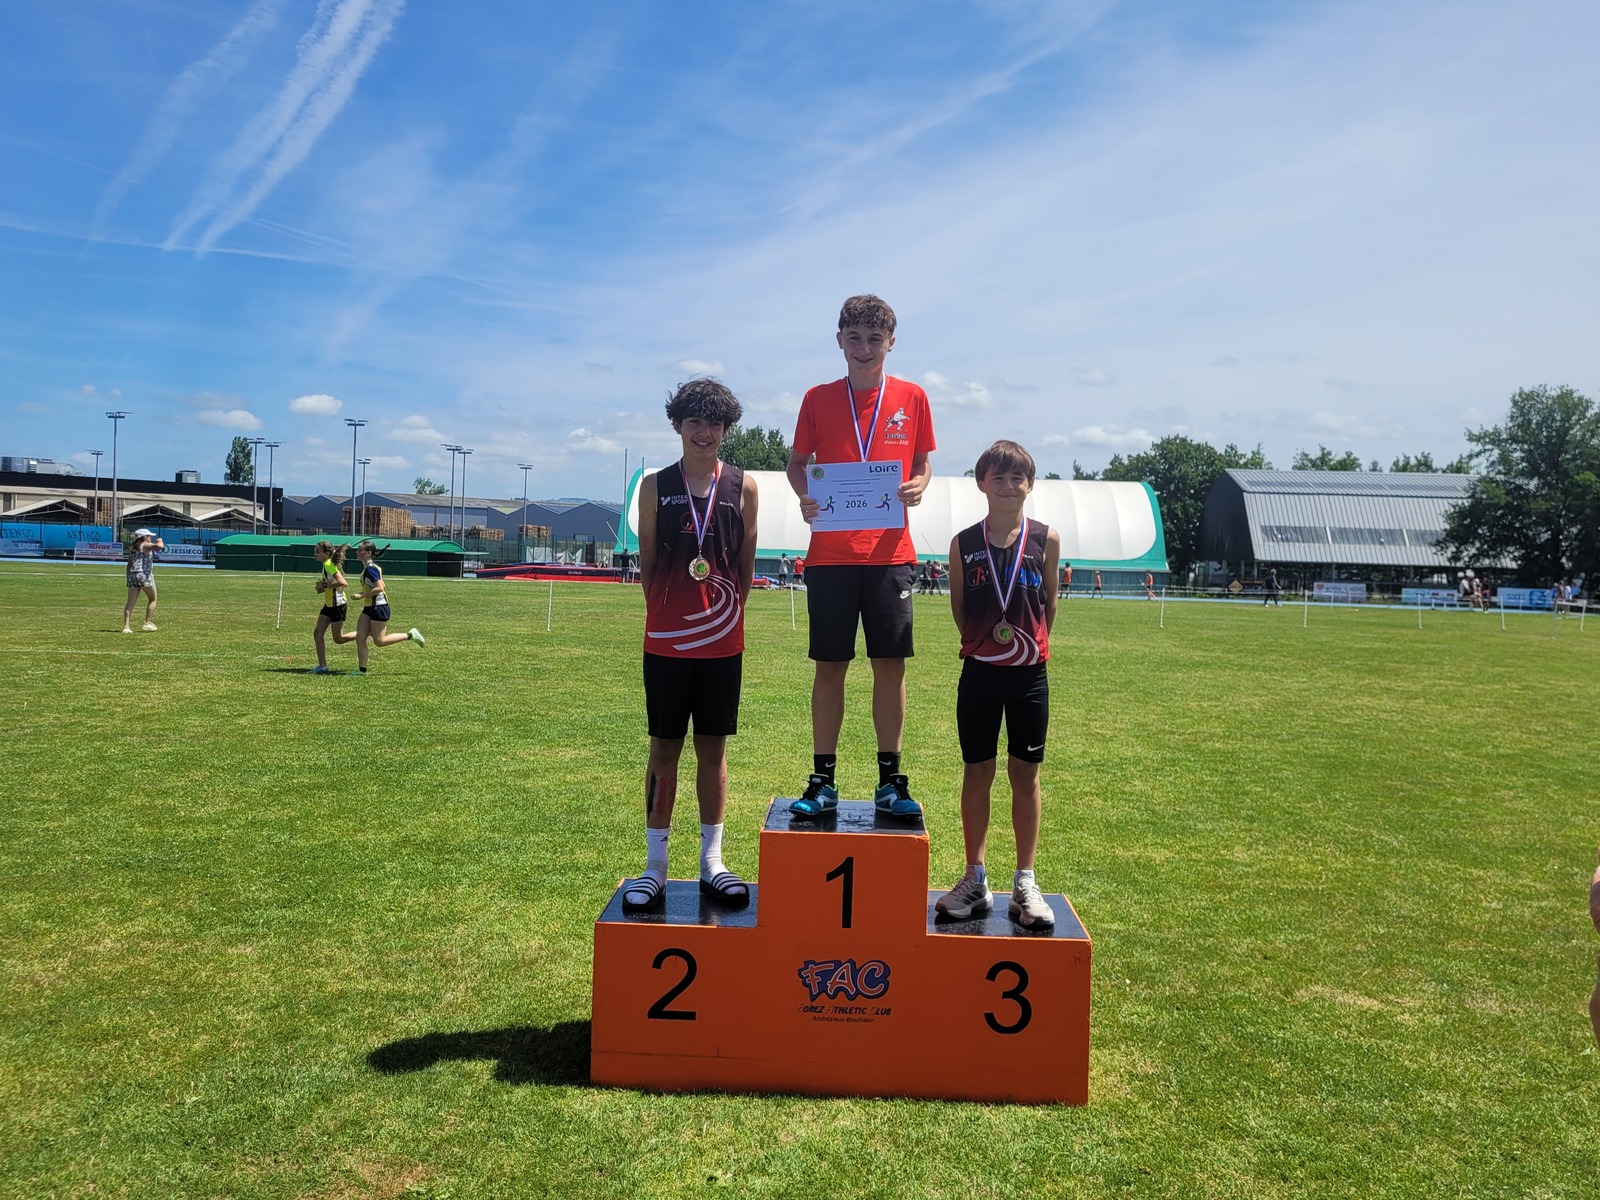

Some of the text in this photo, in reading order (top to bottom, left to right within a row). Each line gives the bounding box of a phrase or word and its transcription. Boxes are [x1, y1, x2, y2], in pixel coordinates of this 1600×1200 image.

[869, 465, 898, 473] Loire
[845, 500, 868, 509] 2026
[0, 528, 35, 539] TENGO
[826, 856, 855, 929] 1
[647, 947, 698, 1021] 2
[799, 960, 888, 999] FAC
[983, 960, 1033, 1035] 3
